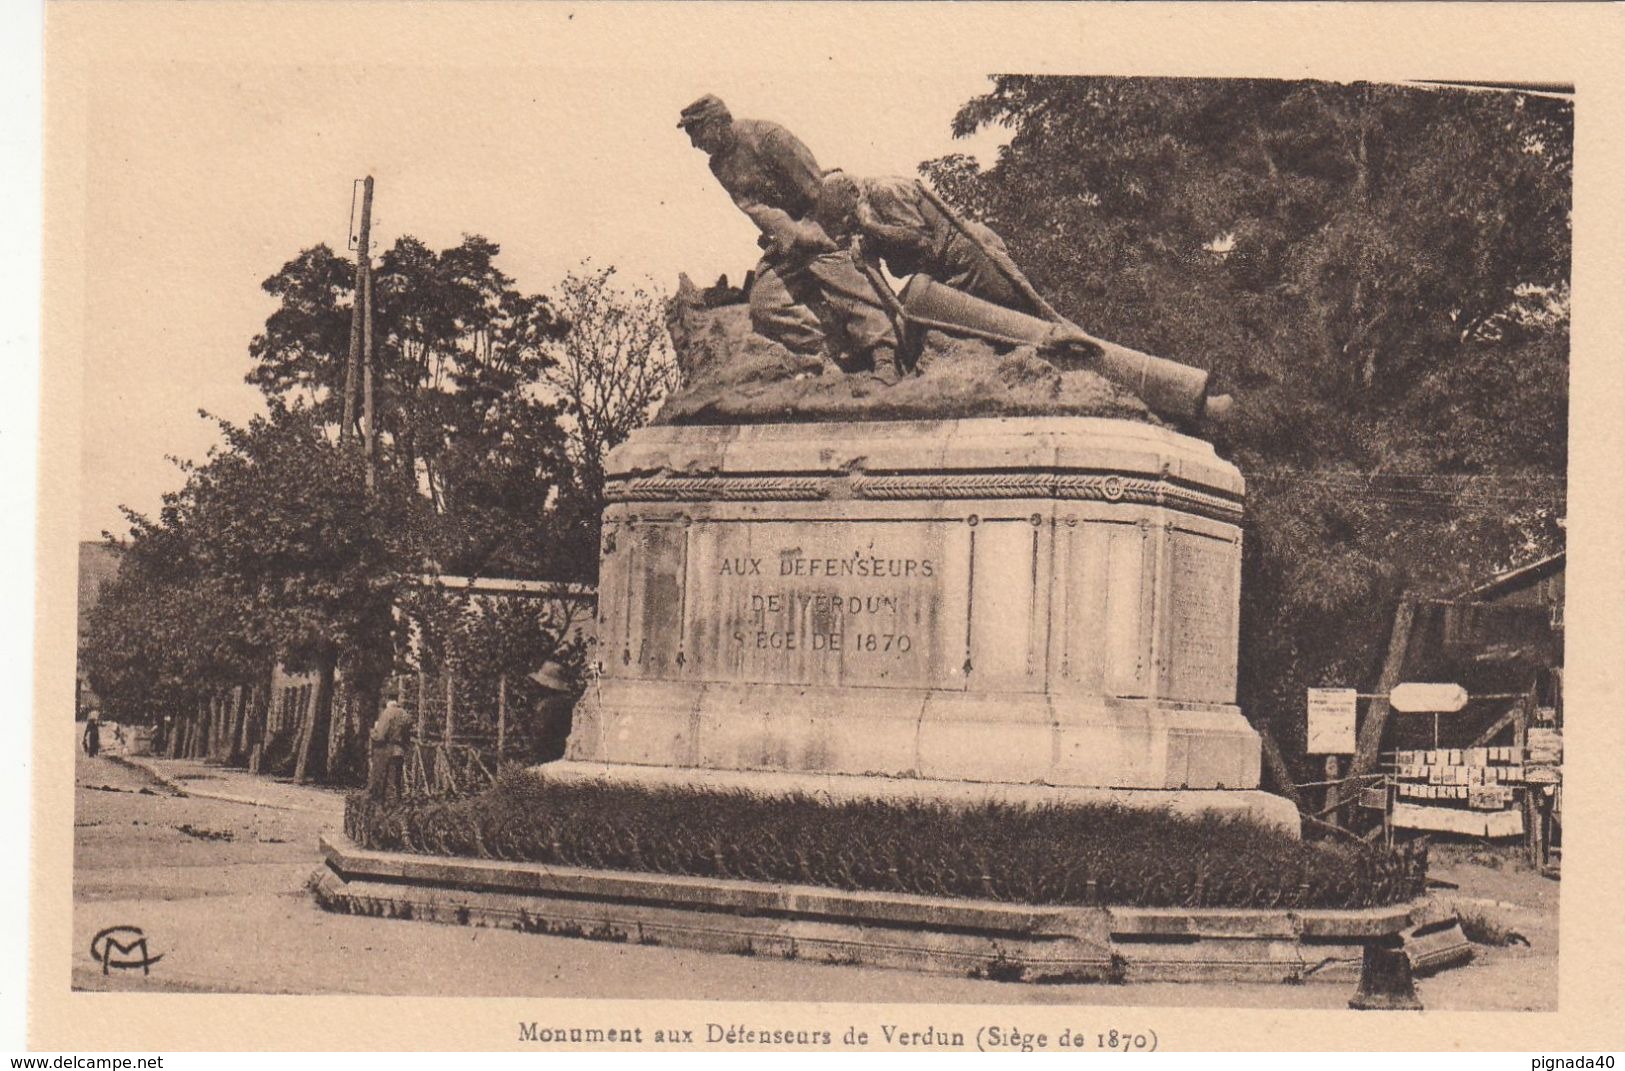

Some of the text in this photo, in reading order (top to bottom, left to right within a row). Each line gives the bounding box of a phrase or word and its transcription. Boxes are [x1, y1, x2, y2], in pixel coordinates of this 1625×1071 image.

[718, 557, 935, 578] AUX DEFENSEURS
[751, 594, 899, 615] DE VERDUN
[732, 630, 913, 653] SEGE DE 1870
